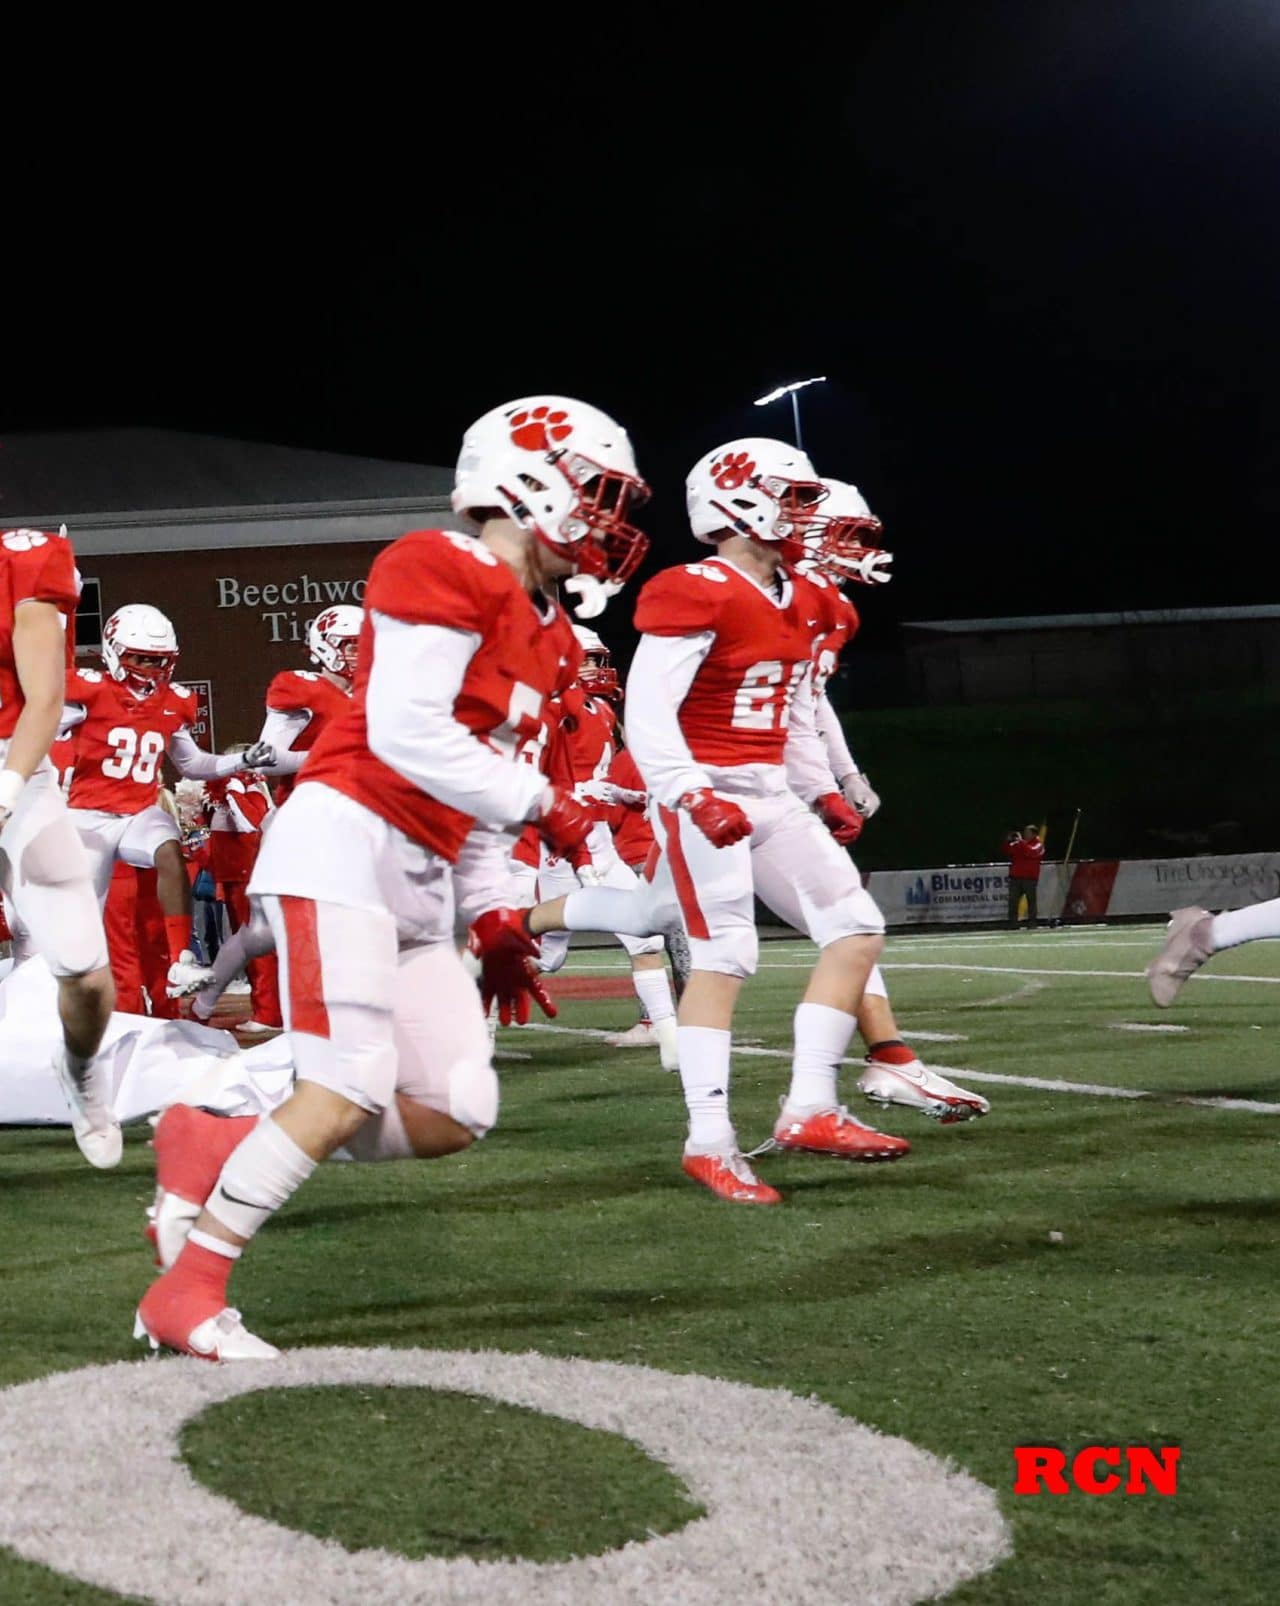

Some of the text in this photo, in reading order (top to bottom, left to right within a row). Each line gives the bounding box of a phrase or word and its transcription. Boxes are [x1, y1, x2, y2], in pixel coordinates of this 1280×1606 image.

[216, 574, 368, 608] Beechwo
[101, 727, 164, 784] 38
[931, 874, 1010, 893] Bluegras
